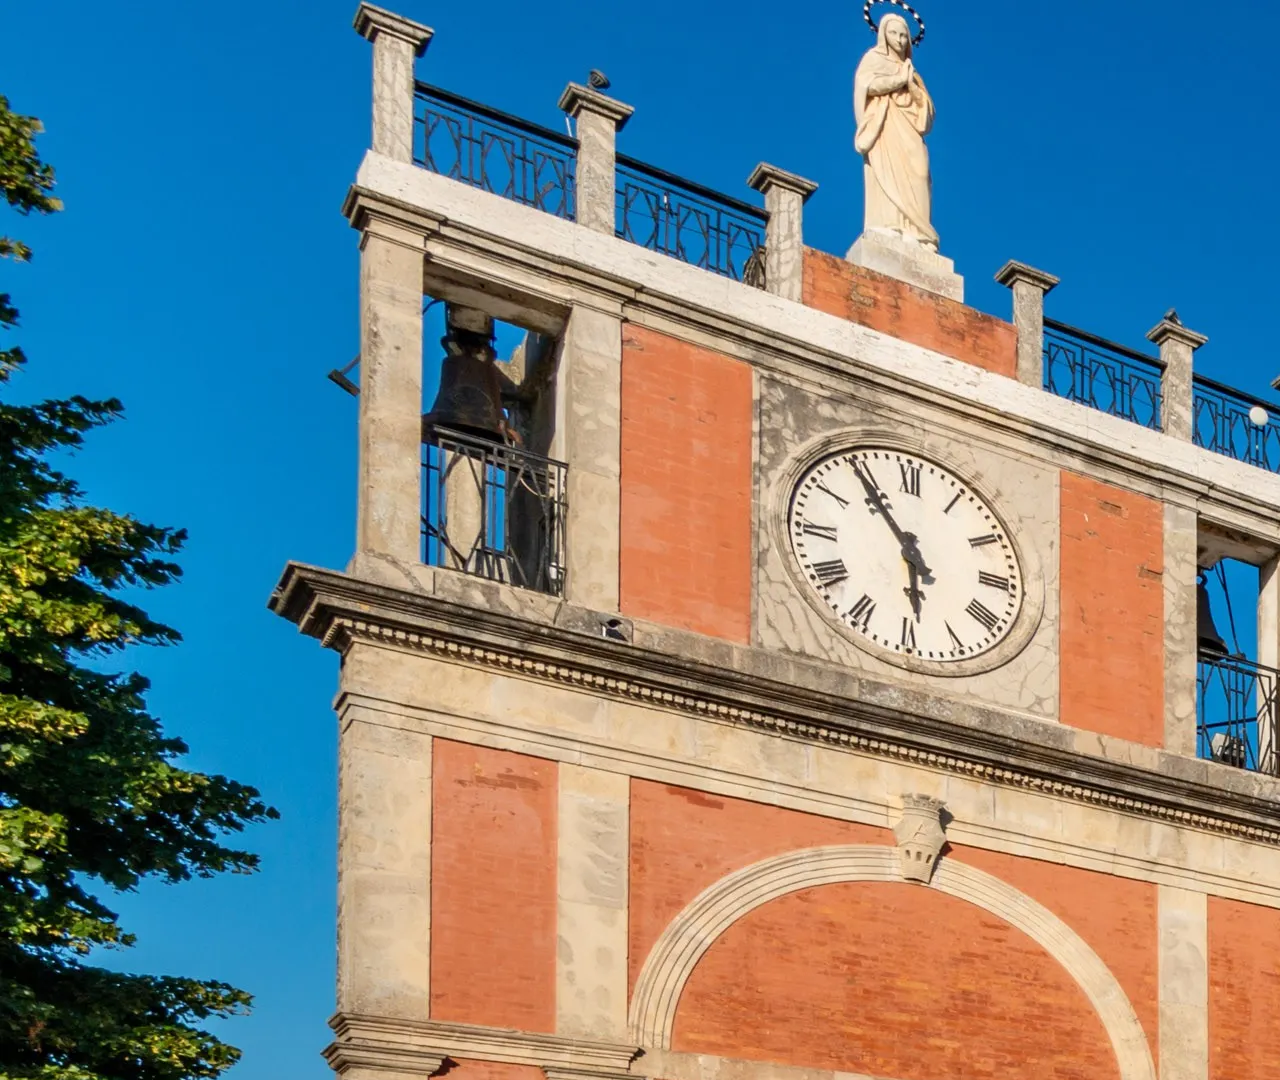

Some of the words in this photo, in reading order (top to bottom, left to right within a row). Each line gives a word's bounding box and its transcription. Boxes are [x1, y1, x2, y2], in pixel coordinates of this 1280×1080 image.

[900, 463, 921, 498] XII
[816, 479, 850, 509] X
[968, 533, 999, 548] II
[978, 570, 1009, 592] III
